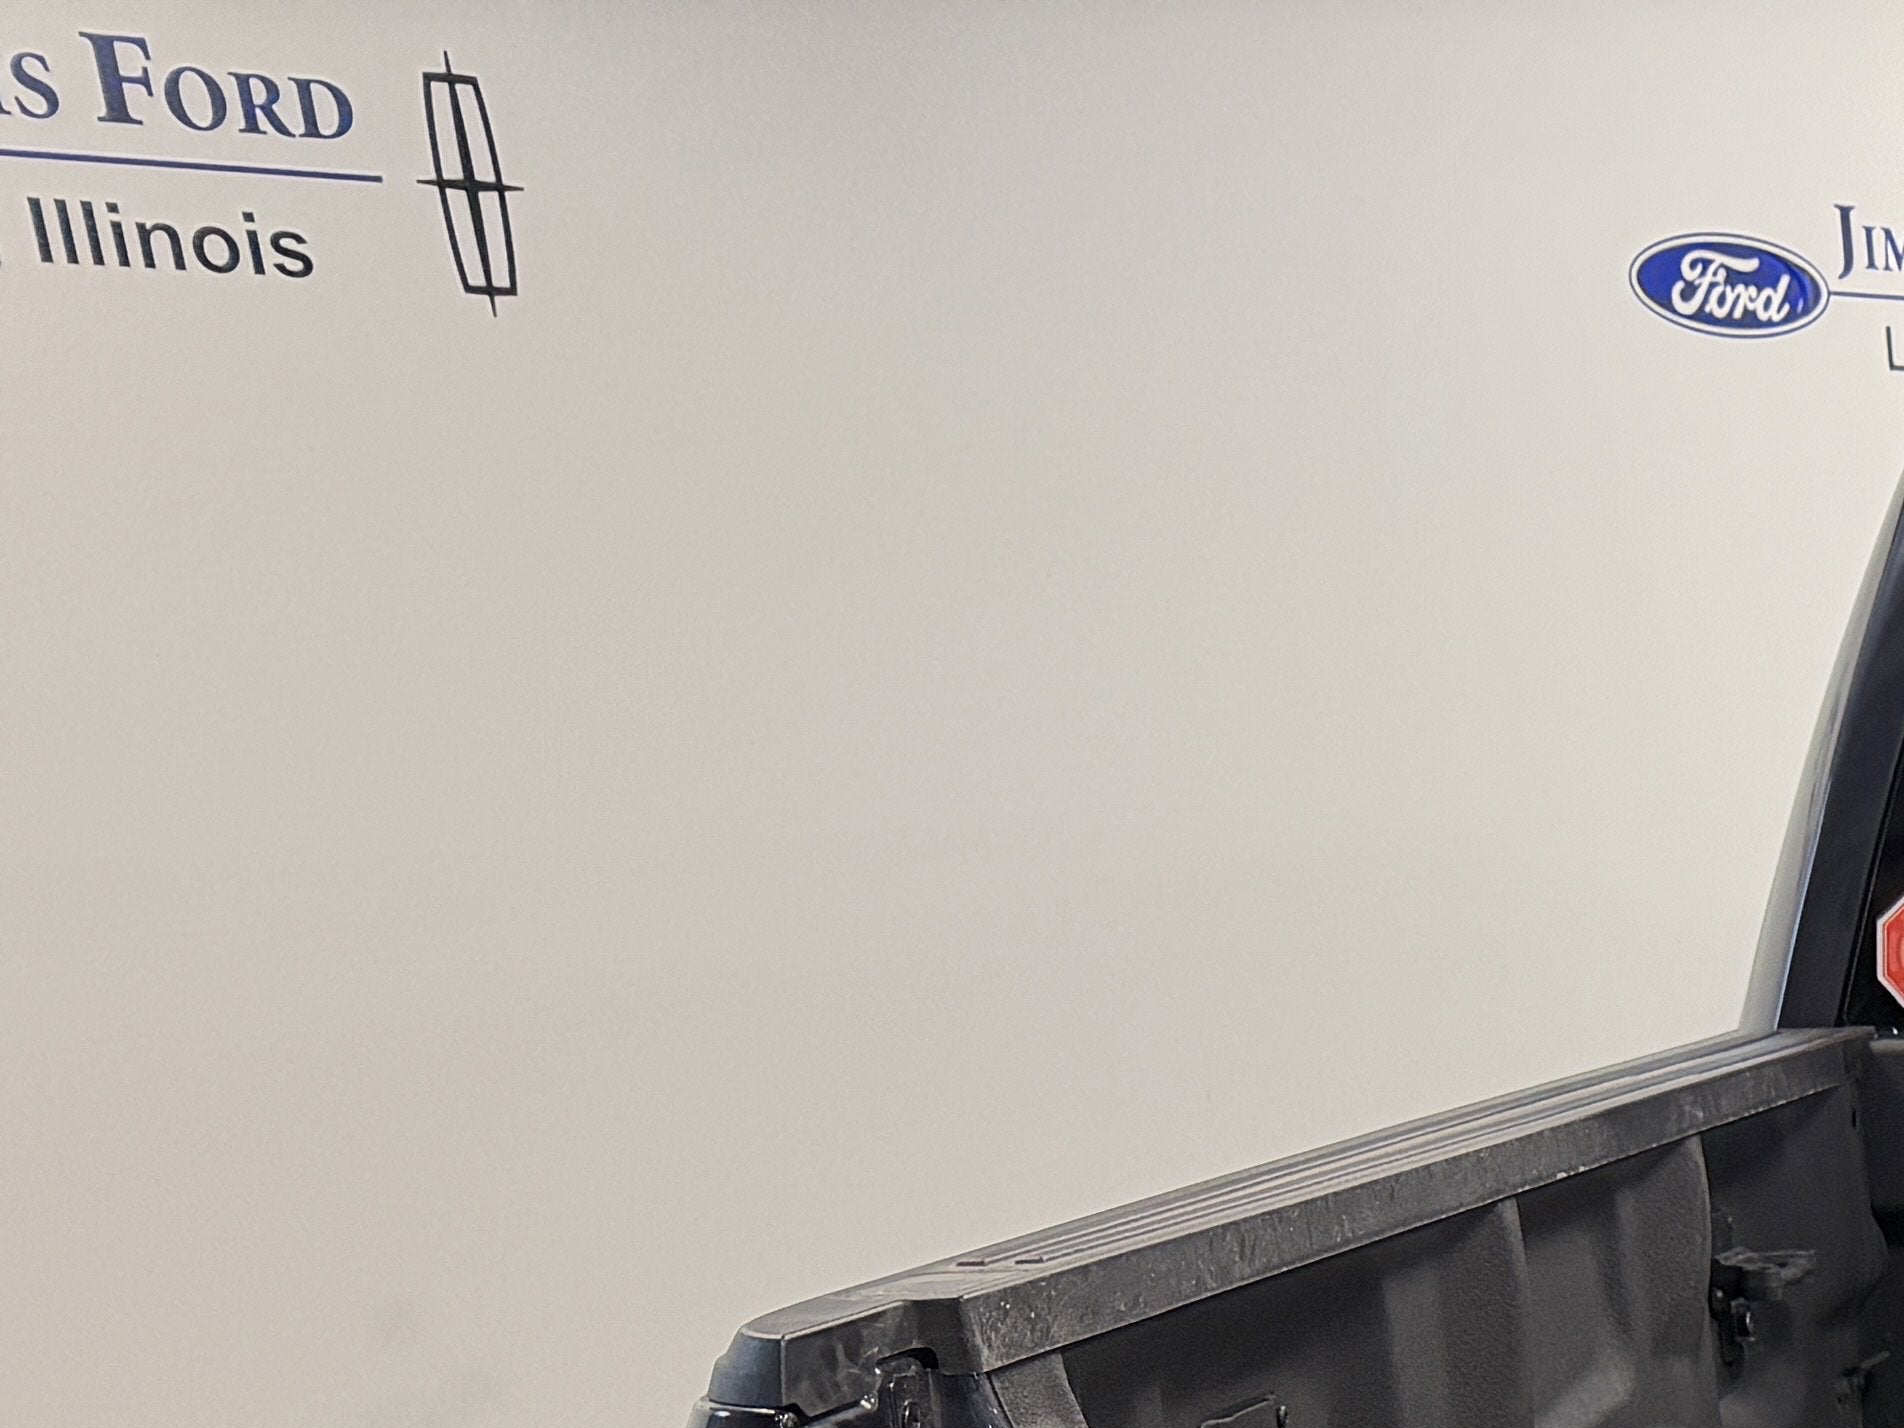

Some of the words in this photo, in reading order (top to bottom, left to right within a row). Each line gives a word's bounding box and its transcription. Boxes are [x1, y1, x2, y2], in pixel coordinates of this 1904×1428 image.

[78, 31, 354, 140] FORD
[26, 196, 314, 279] Illinois
[1670, 249, 1790, 323] Ford
